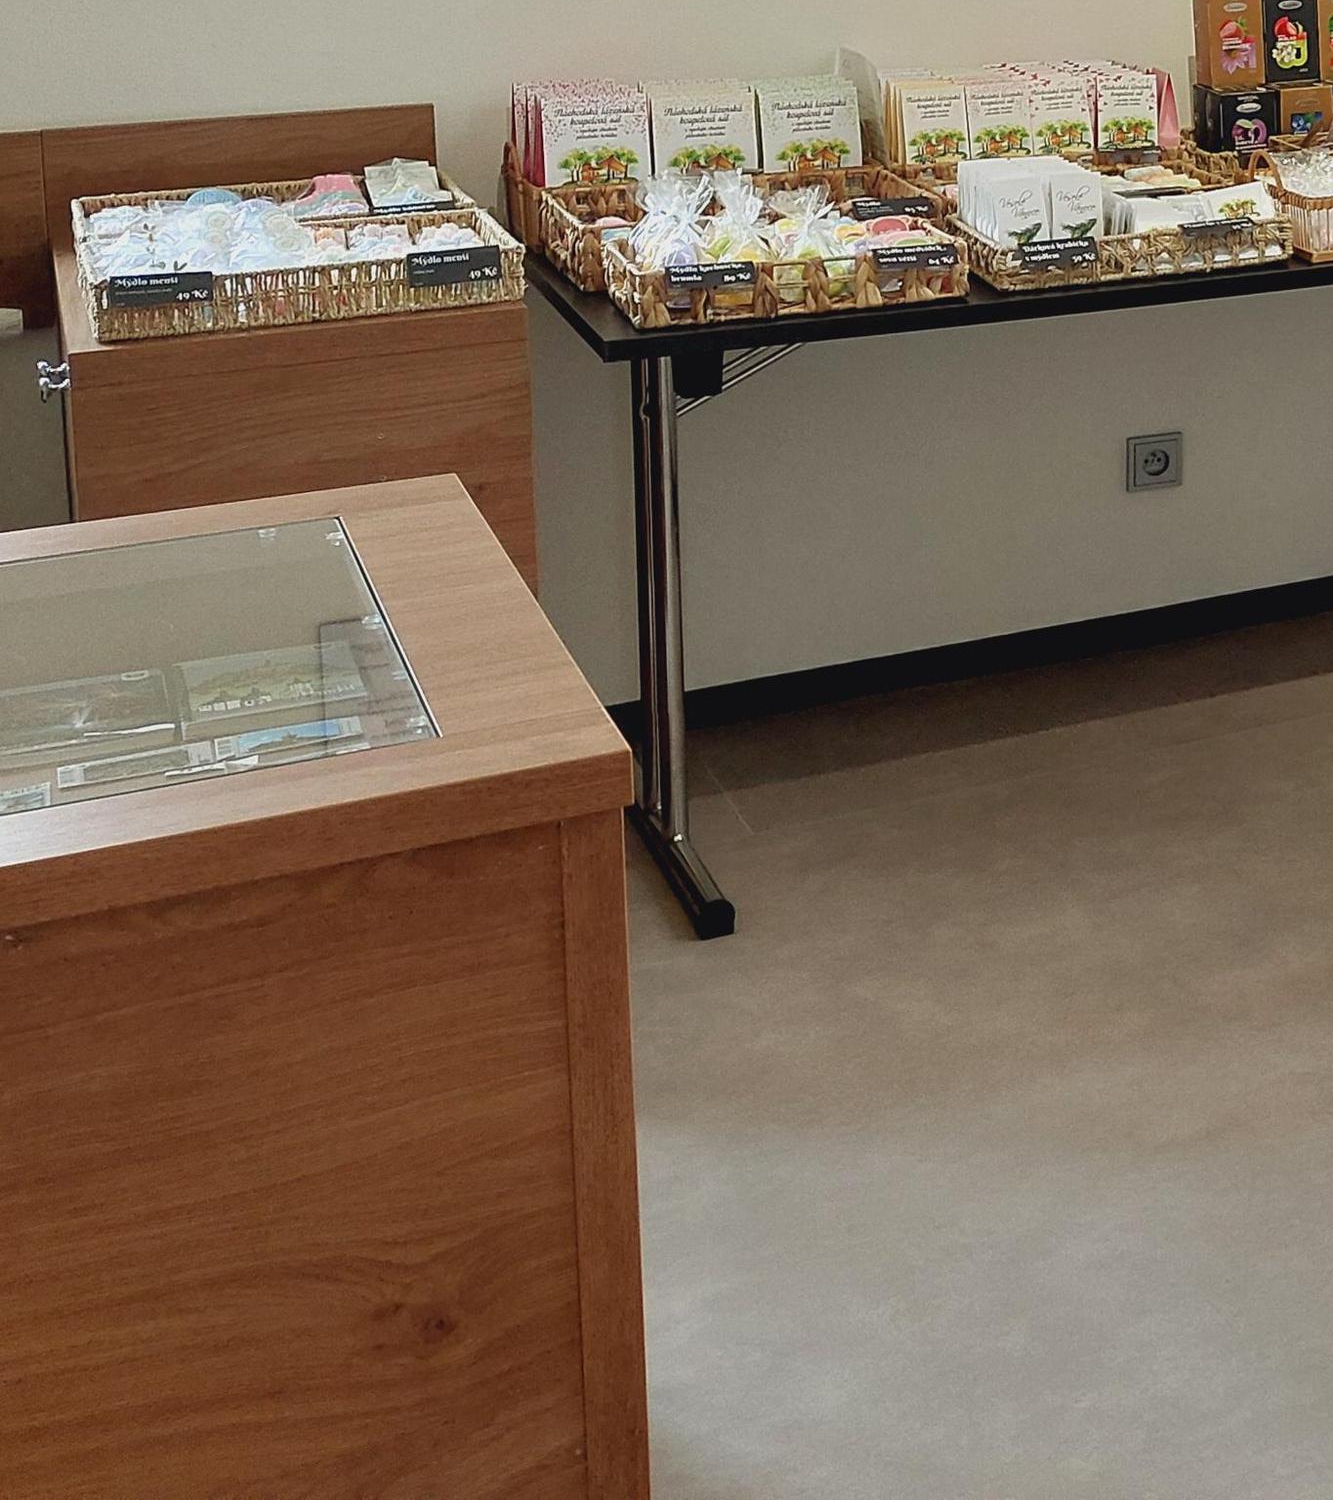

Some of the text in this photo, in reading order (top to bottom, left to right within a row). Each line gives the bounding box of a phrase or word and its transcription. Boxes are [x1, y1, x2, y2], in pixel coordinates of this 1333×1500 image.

[411, 253, 469, 266] Mýdlo menší
[468, 266, 498, 279] 49 Kč
[114, 277, 178, 288] Mýdlo menší
[176, 289, 209, 300] 49 Kč
